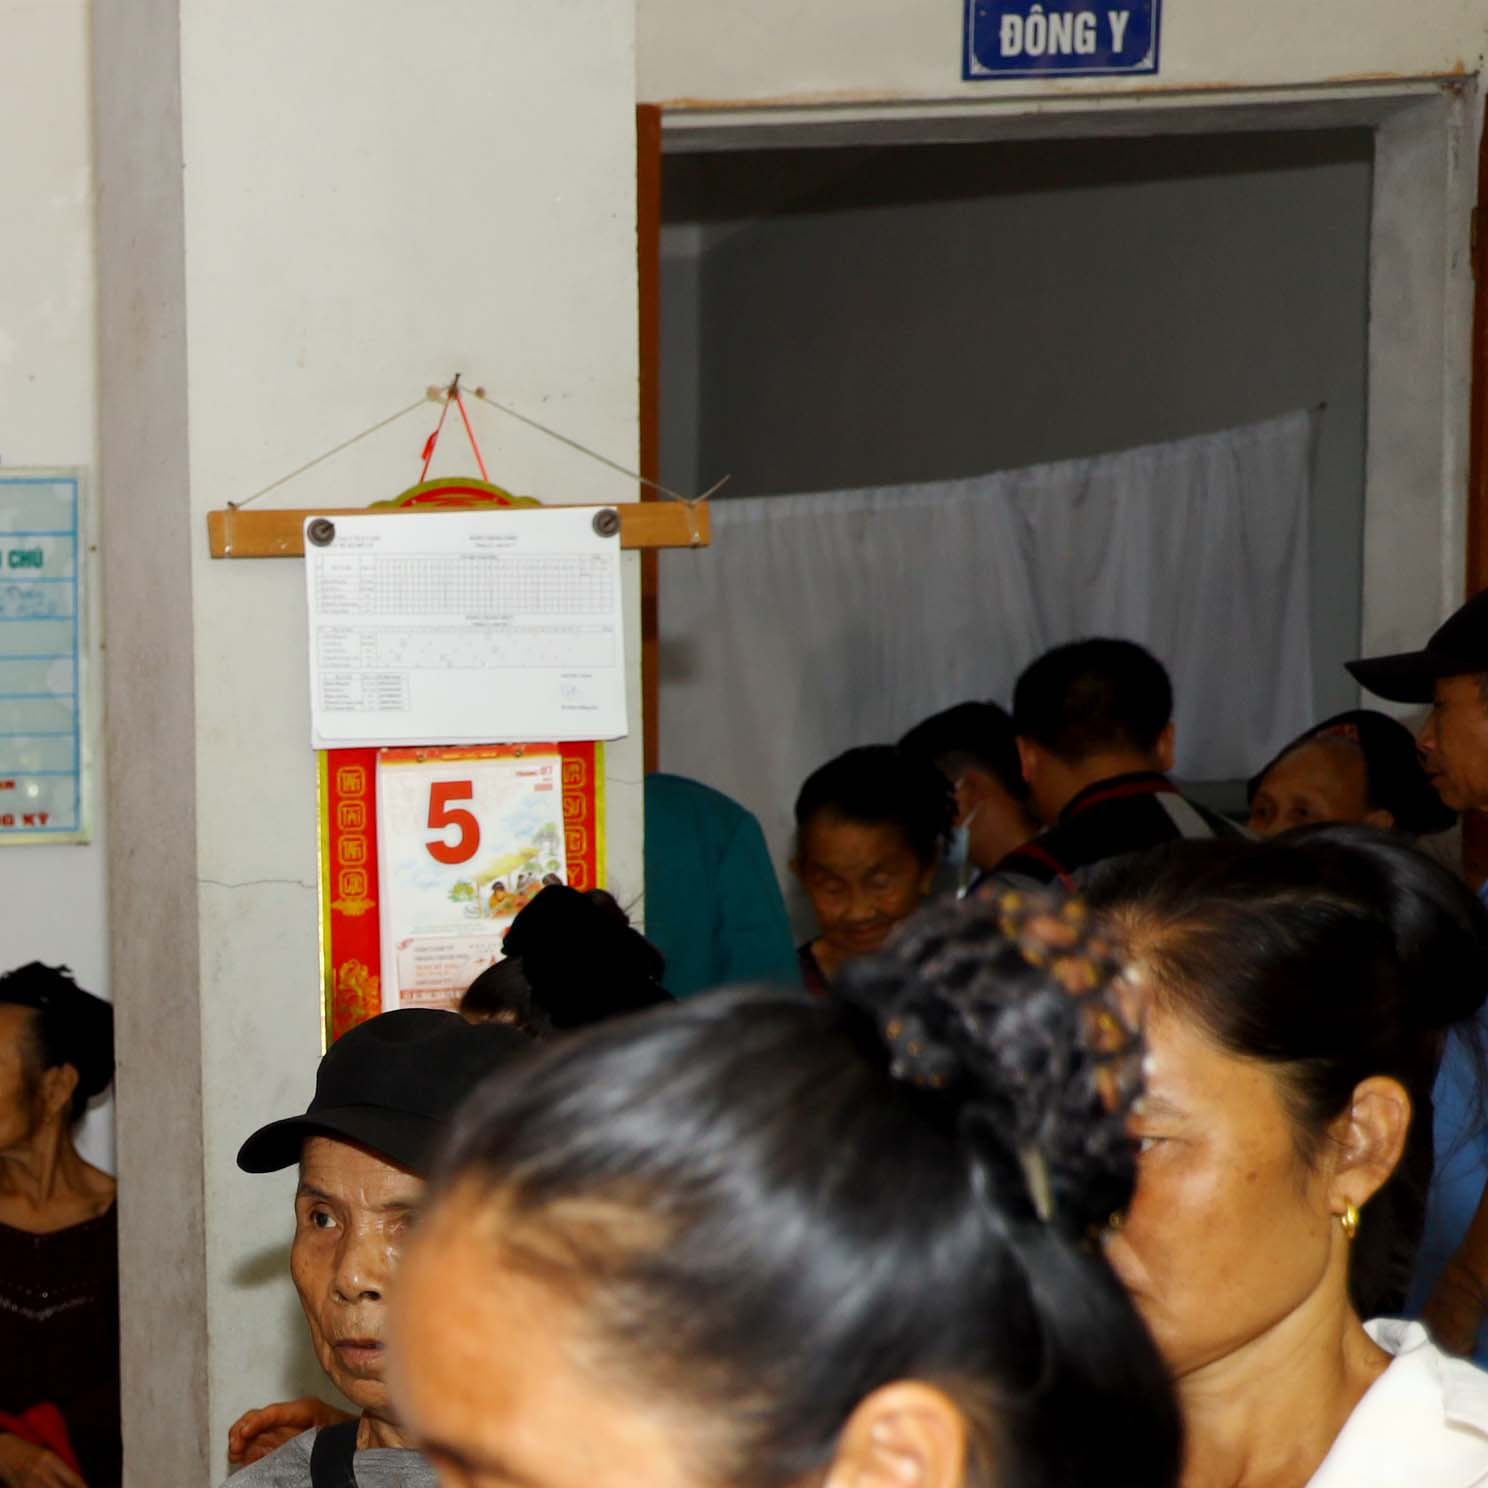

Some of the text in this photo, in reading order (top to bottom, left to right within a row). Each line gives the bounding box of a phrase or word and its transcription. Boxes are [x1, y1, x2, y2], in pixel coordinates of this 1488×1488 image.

[1000, 4, 1130, 56] ĐÔNG Y
[7, 547, 43, 568] CHÚ
[425, 780, 481, 865] 5
